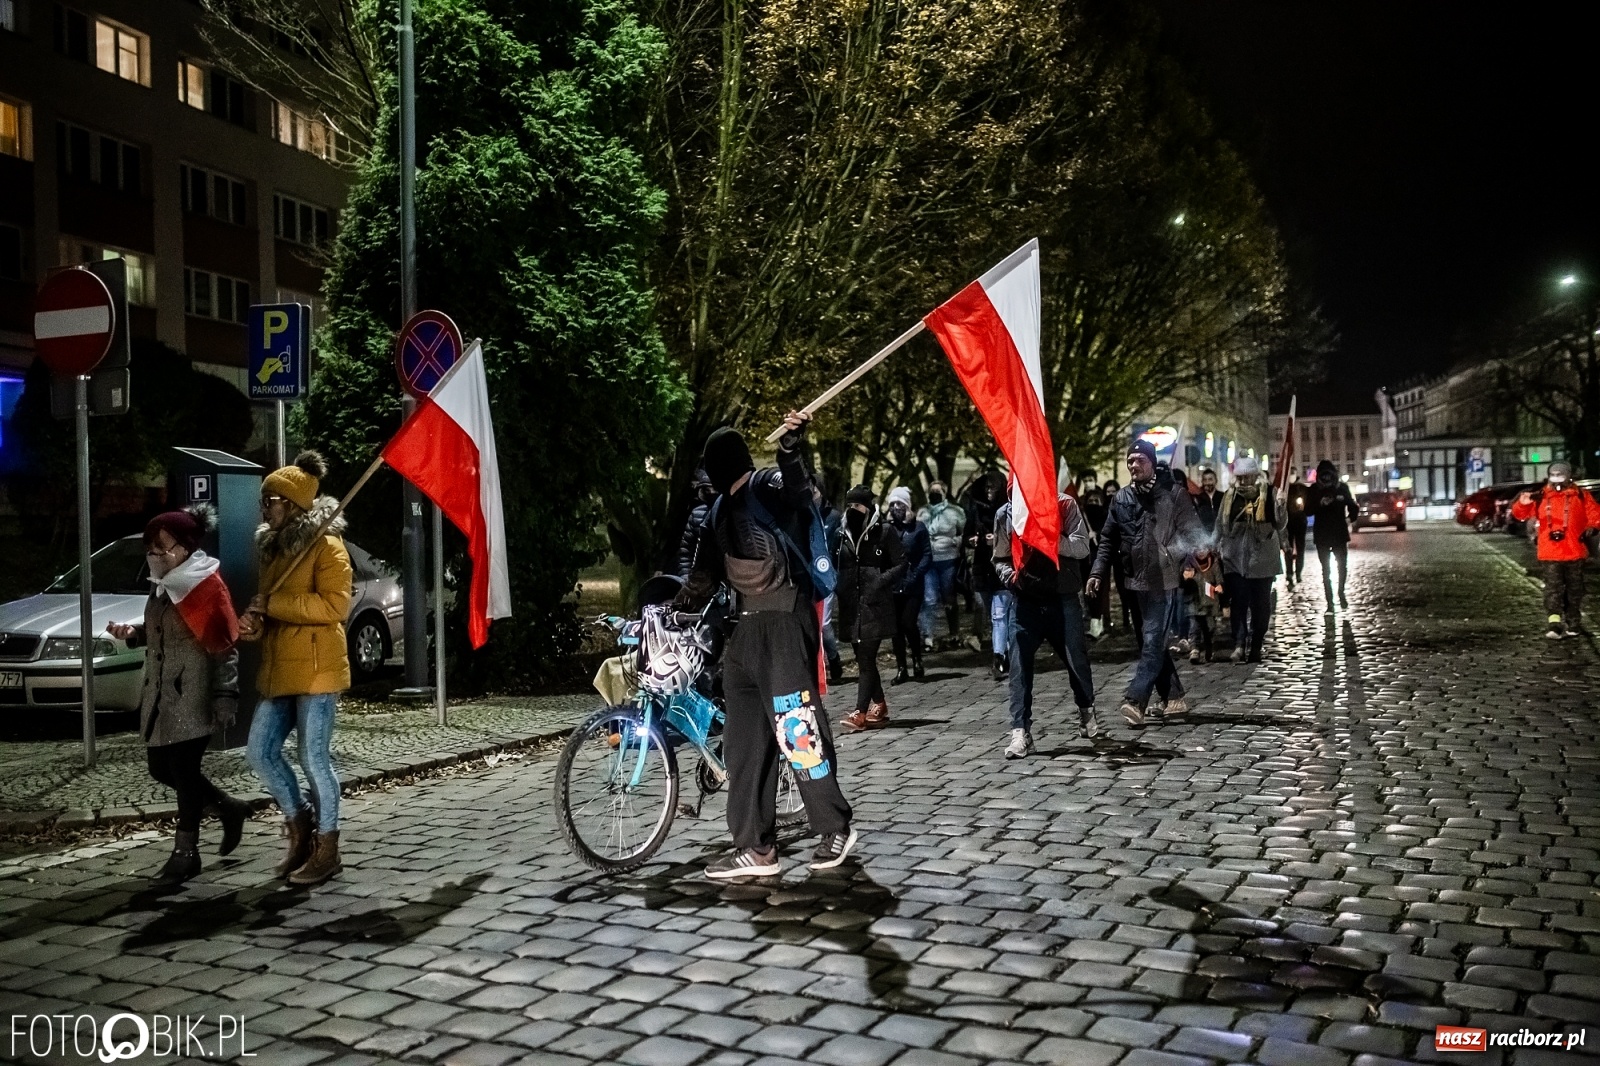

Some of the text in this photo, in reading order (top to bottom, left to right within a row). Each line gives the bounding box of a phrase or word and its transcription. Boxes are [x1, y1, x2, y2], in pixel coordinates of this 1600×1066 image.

[263, 310, 289, 349] P
[252, 384, 295, 394] PARKOMAT
[194, 477, 207, 499] P
[773, 690, 810, 713] WHERE IS
